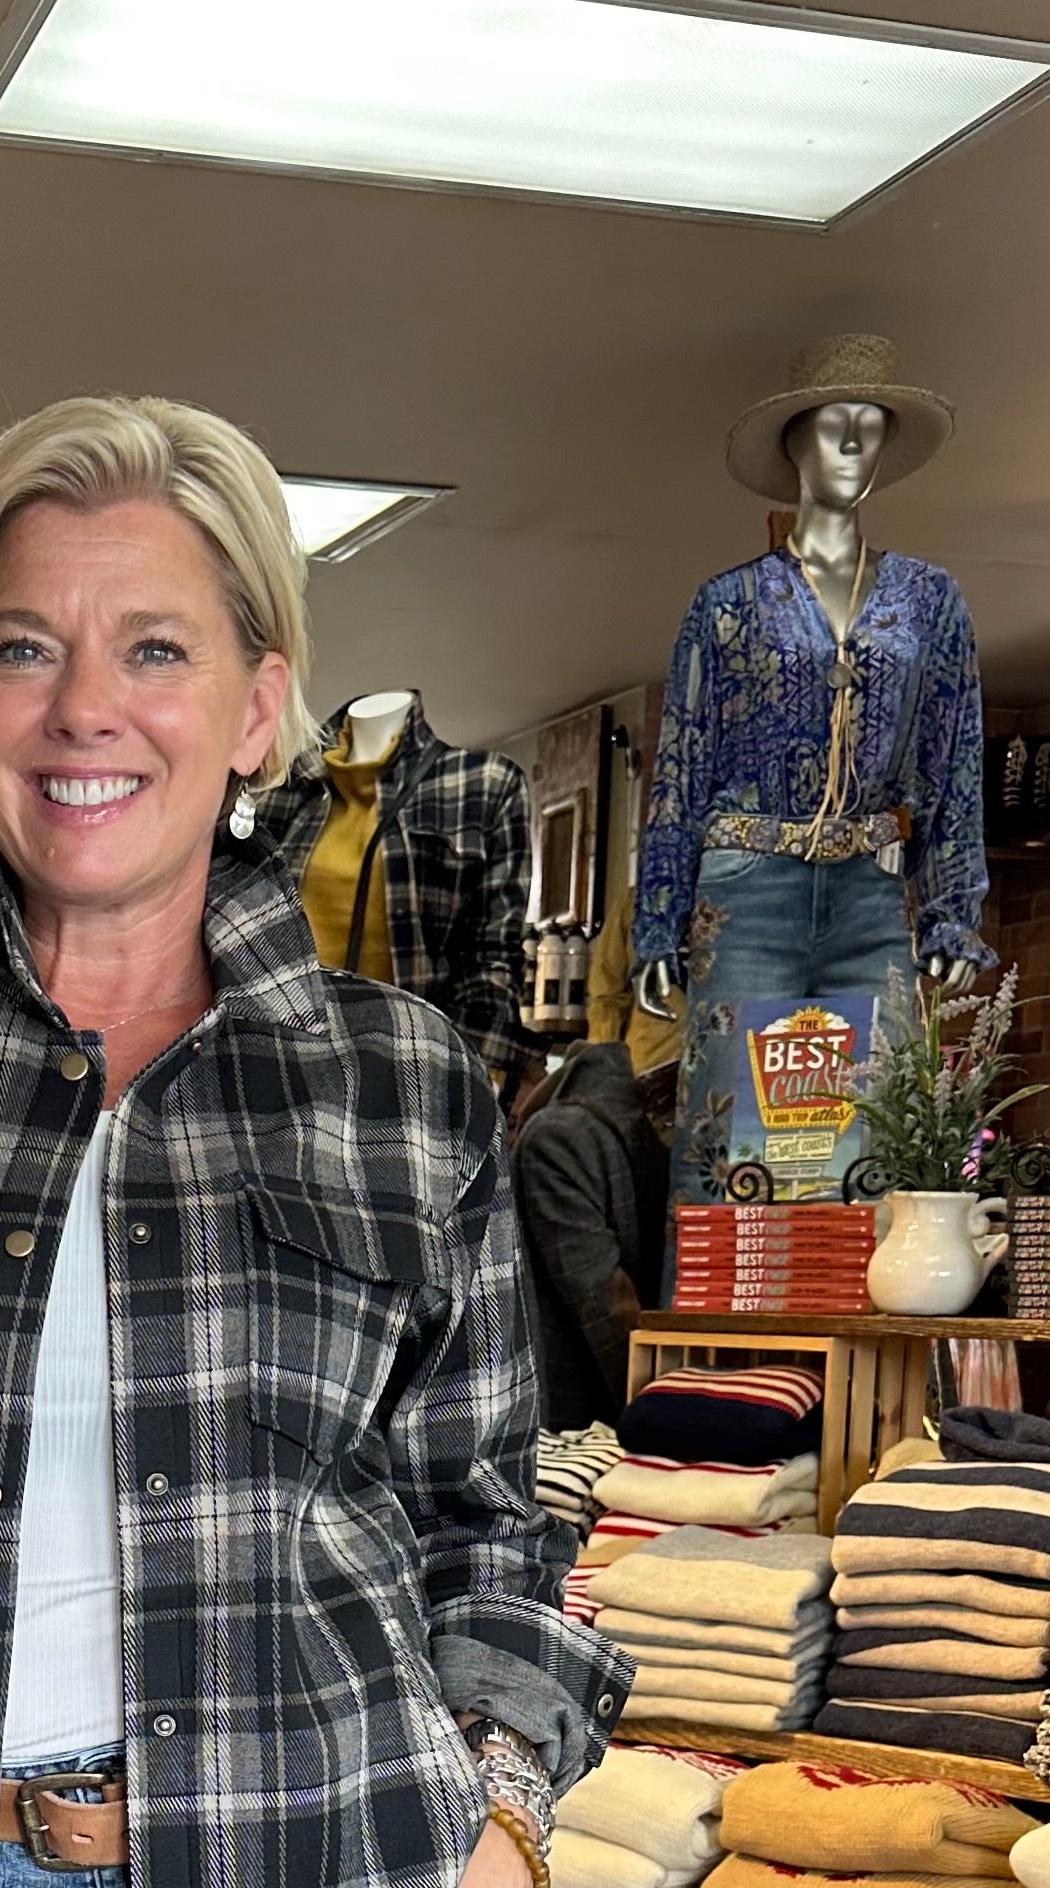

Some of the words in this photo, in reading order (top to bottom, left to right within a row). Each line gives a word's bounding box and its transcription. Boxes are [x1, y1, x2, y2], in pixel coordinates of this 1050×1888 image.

[799, 1020, 818, 1031] THE
[764, 1035, 847, 1073] BEST
[735, 1207, 765, 1220] BEST
[736, 1223, 765, 1236] BEST
[736, 1238, 765, 1251] BEST
[735, 1253, 765, 1267] BEST
[736, 1268, 765, 1281] BEST
[734, 1283, 762, 1296] BEST
[731, 1298, 760, 1311] BEST
